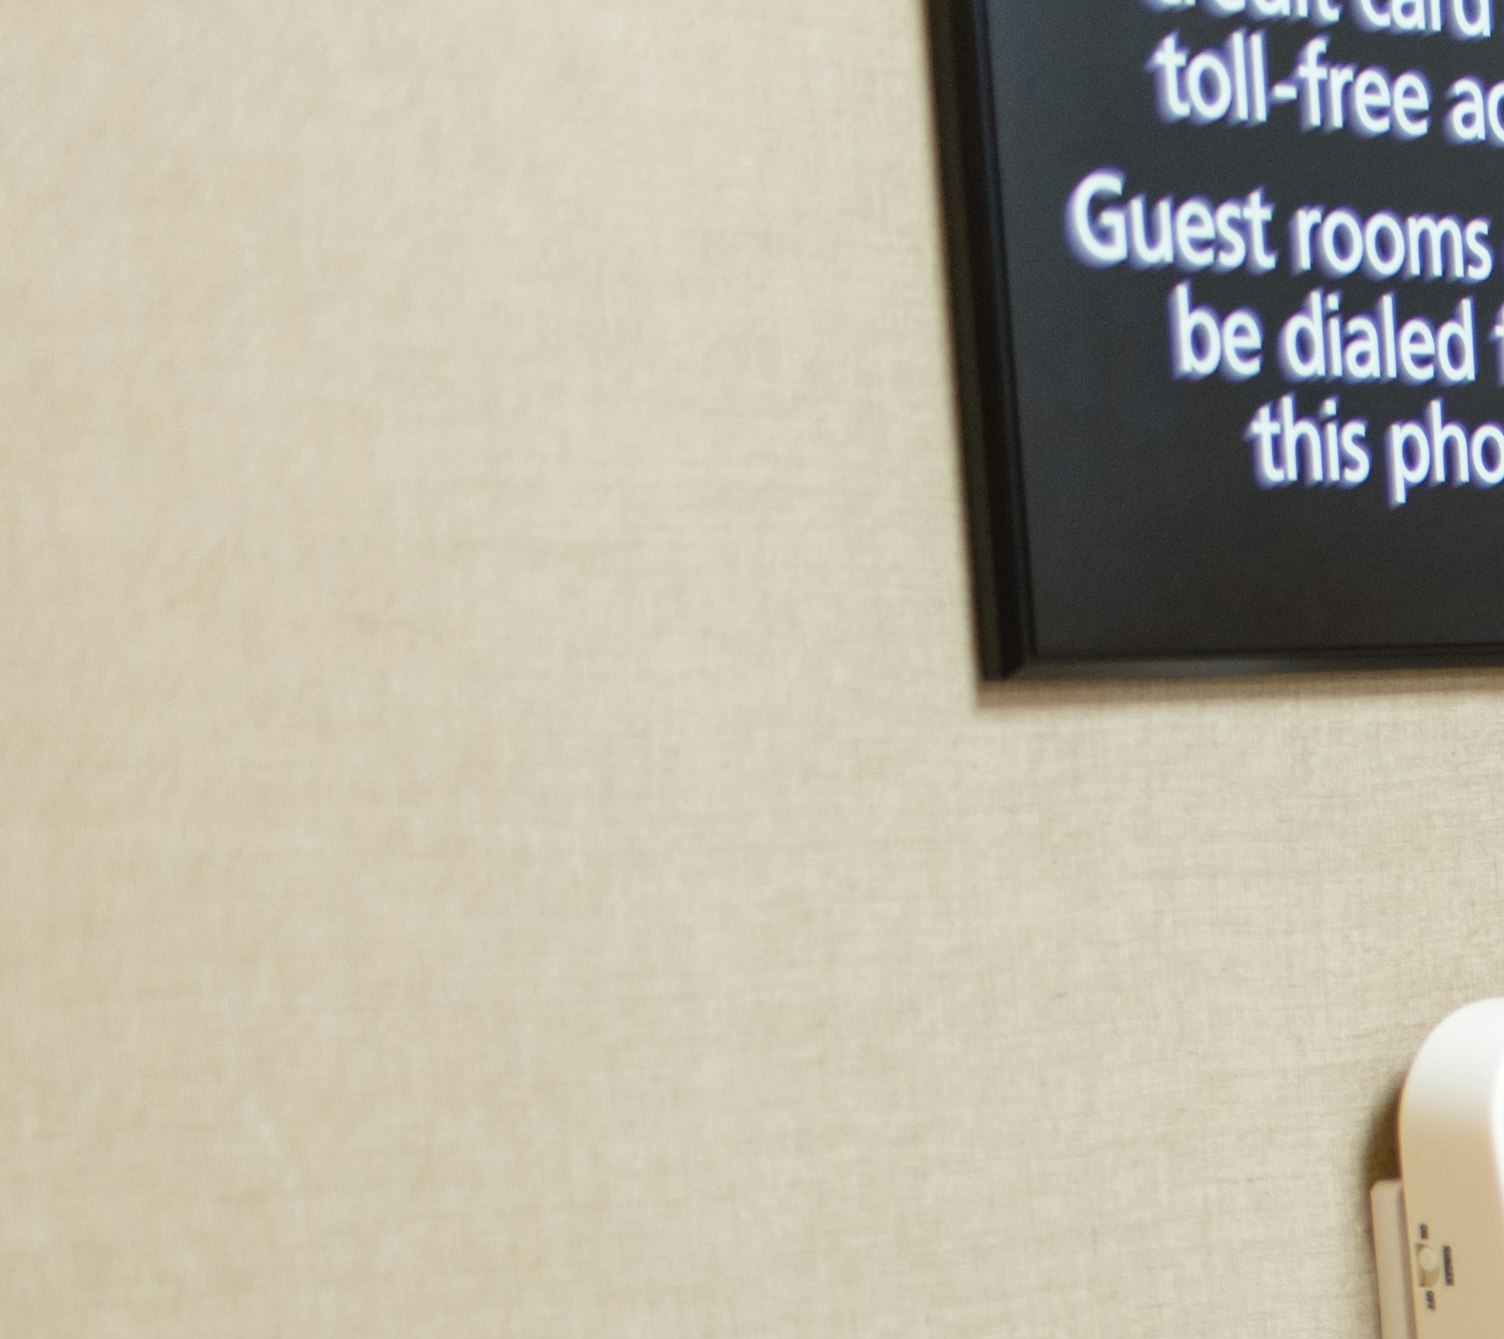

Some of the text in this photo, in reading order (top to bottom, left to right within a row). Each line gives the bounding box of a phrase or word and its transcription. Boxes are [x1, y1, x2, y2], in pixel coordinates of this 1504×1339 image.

[1150, 29, 1431, 138] toll-free
[1068, 169, 1276, 272] Guest
[1292, 205, 1493, 283] rooms
[1171, 281, 1262, 380] be
[1282, 289, 1476, 385] dialed
[1247, 394, 1370, 488] this
